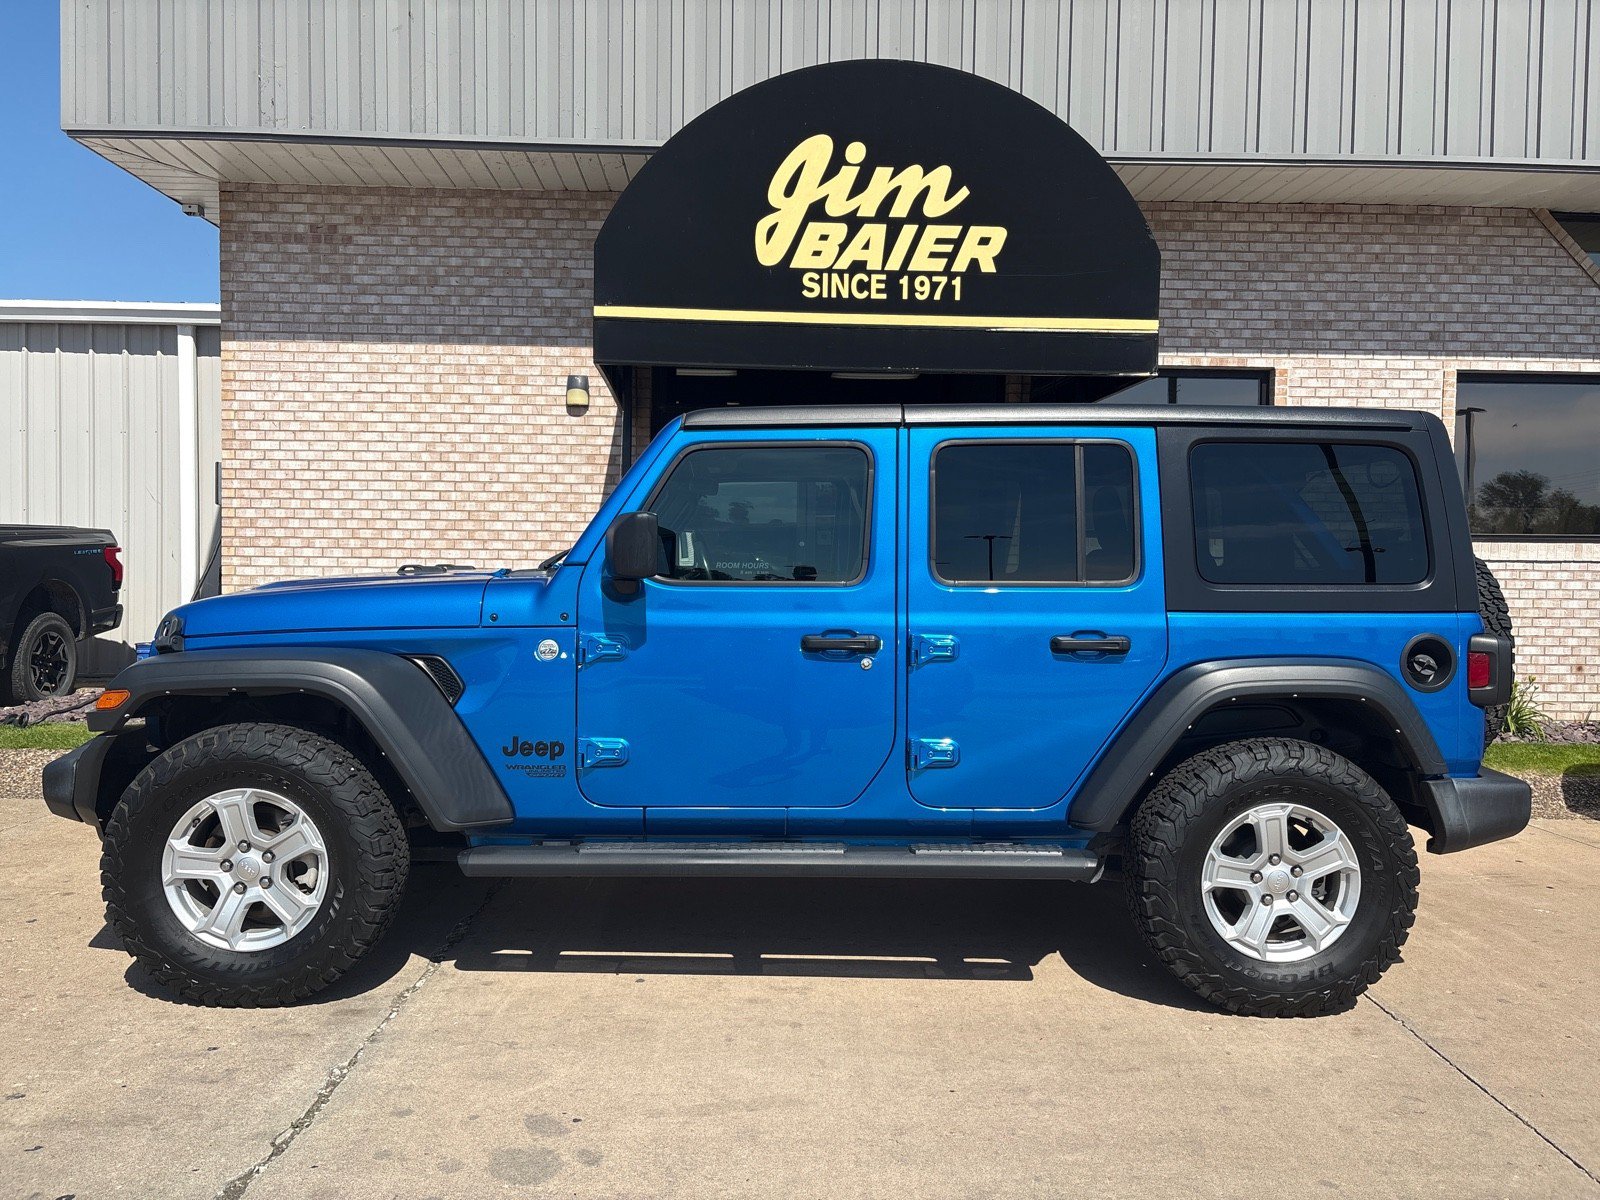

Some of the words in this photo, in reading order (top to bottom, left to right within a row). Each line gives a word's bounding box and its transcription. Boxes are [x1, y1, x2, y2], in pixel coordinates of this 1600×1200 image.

[754, 133, 970, 267] Jim
[789, 221, 1008, 273] BAIER
[801, 271, 887, 300] SINCE
[899, 275, 962, 301] 1971
[502, 736, 565, 760] Jeep
